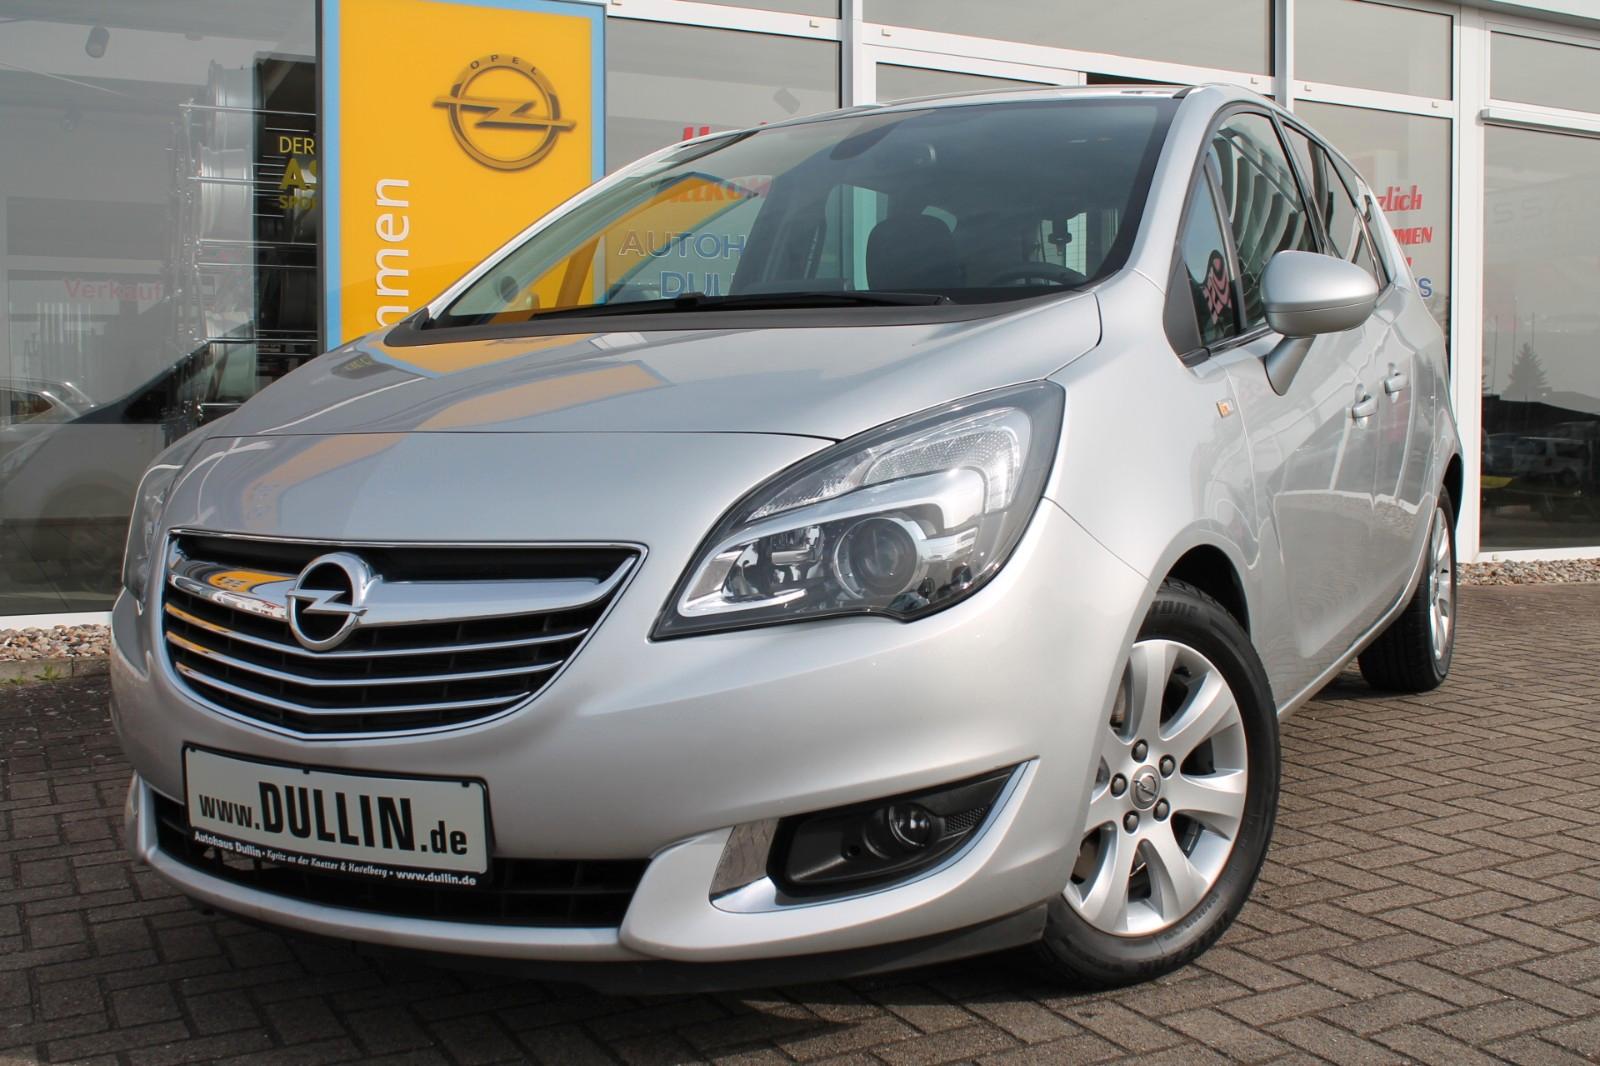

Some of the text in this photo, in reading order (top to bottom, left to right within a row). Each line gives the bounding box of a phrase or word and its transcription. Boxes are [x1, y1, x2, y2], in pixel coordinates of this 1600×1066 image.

[470, 54, 537, 75] OPEL
[280, 136, 315, 155] DER
[64, 278, 163, 302] Verkauf
[199, 781, 467, 855] www.DULLIN.de
[195, 831, 233, 850] Autohaus
[235, 842, 261, 858] Dullin
[298, 856, 309, 865] der
[341, 862, 346, 871] &
[349, 863, 388, 877] Havelberg
[396, 871, 477, 886] www.dullin.de
